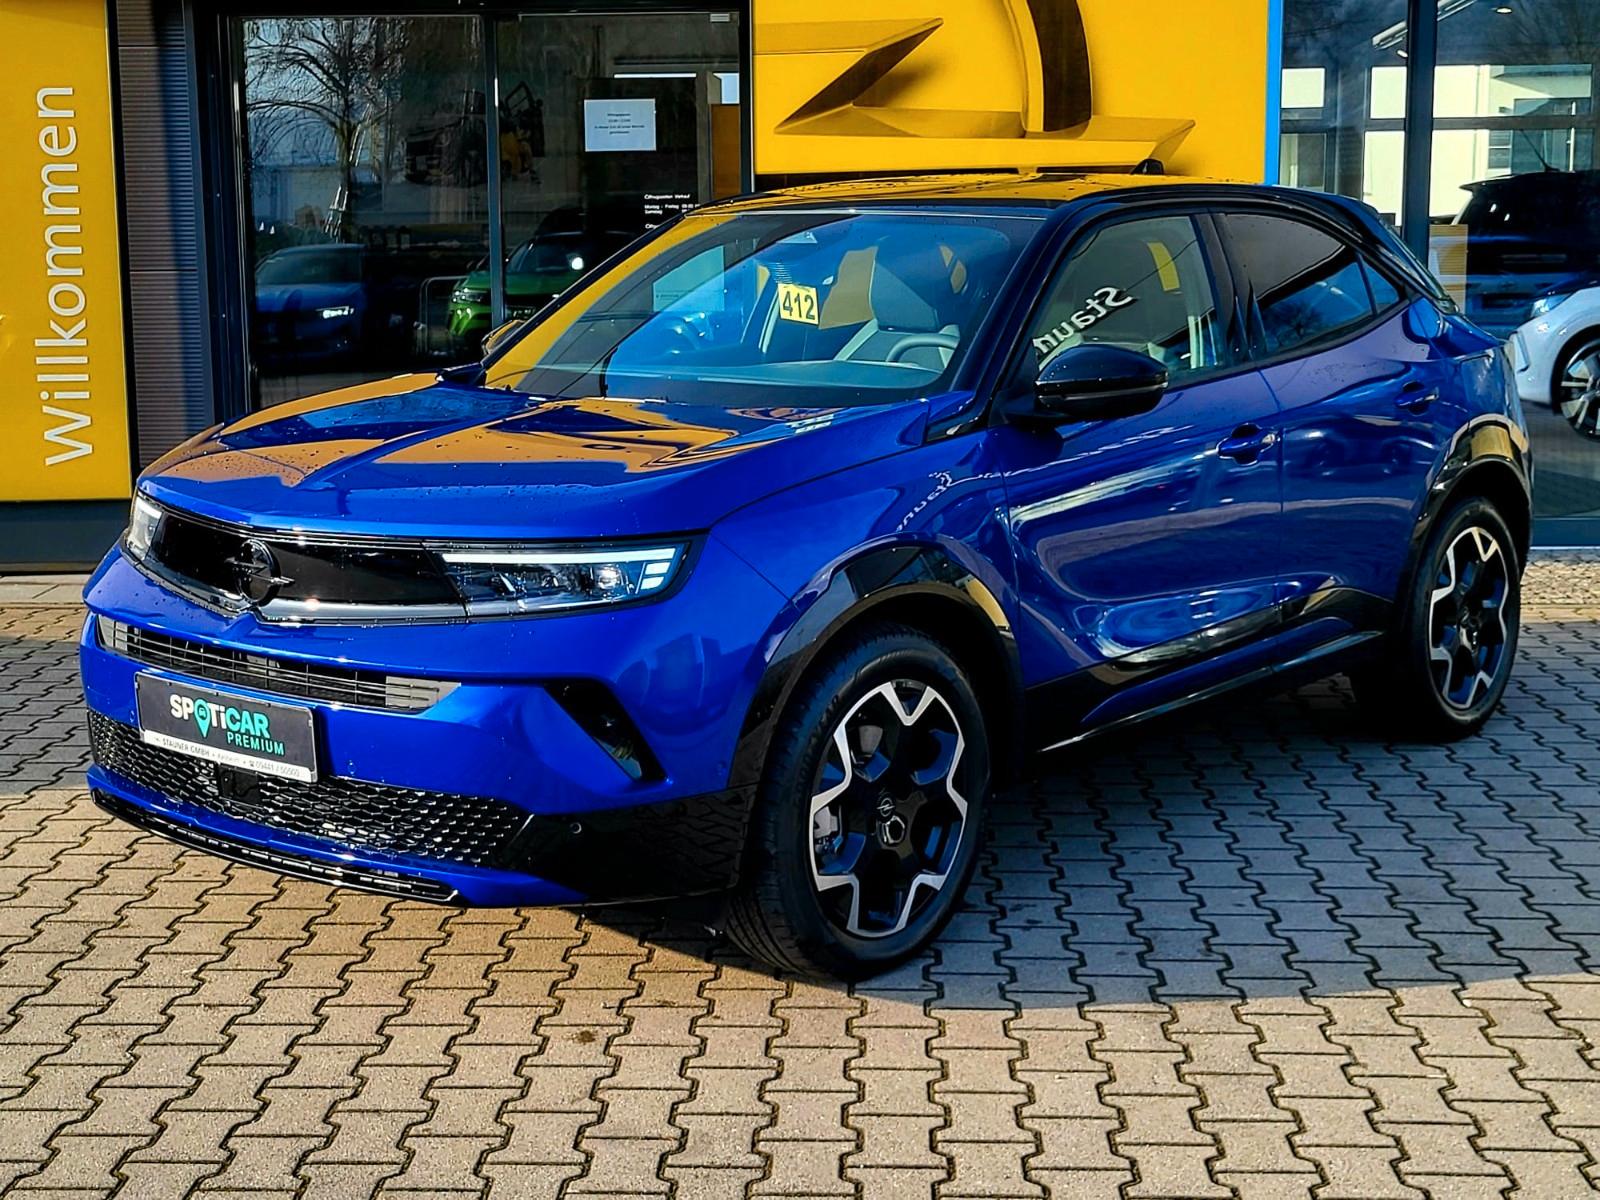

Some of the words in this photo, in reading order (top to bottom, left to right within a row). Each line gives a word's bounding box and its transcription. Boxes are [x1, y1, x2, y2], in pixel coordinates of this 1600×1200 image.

[34, 86, 94, 467] Willkommen
[782, 291, 816, 321] 412
[226, 731, 285, 756] PREMIUM
